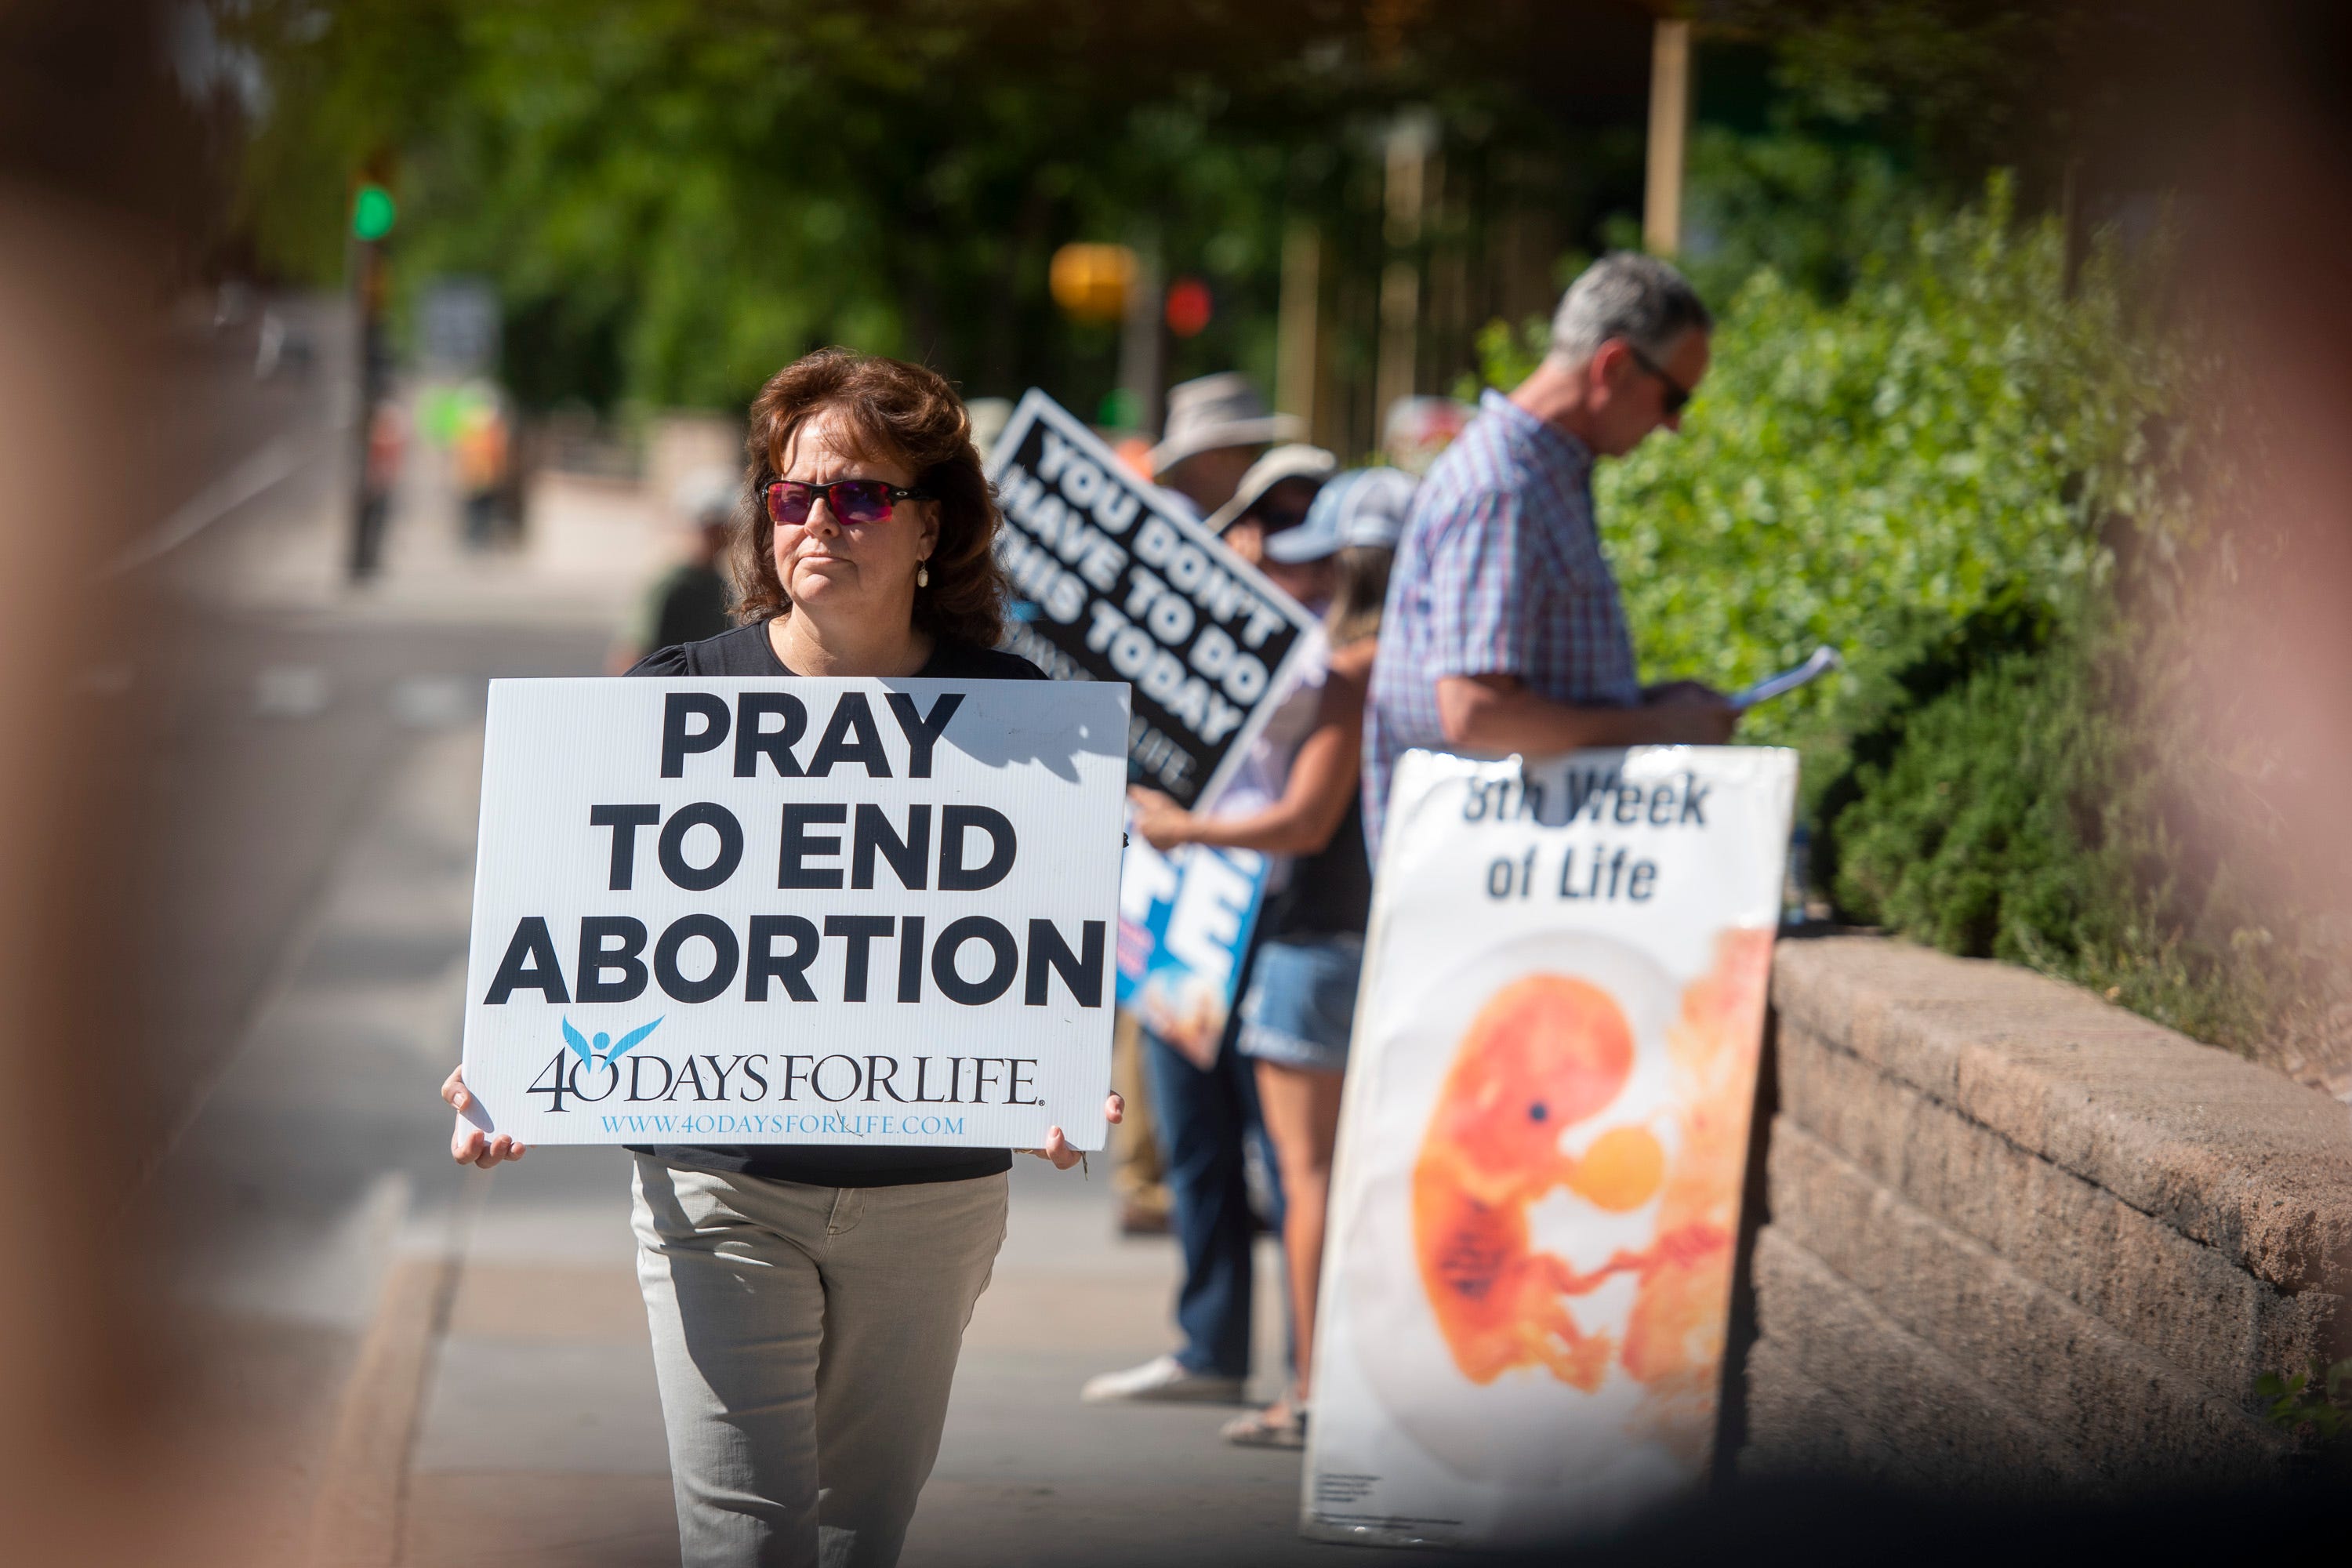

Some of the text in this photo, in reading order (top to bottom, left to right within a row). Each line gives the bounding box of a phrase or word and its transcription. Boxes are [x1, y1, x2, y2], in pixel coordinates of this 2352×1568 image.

[996, 462, 1129, 593] HAVE
[1123, 565, 1196, 647] TO
[1187, 625, 1270, 706] DO
[1039, 429, 1290, 650] YOU DON'T
[1086, 599, 1243, 746] TODAY
[660, 691, 967, 779] PRAY
[590, 801, 1018, 891] TO END
[1486, 844, 1659, 902] of Life
[482, 913, 1106, 1008] ABORTION
